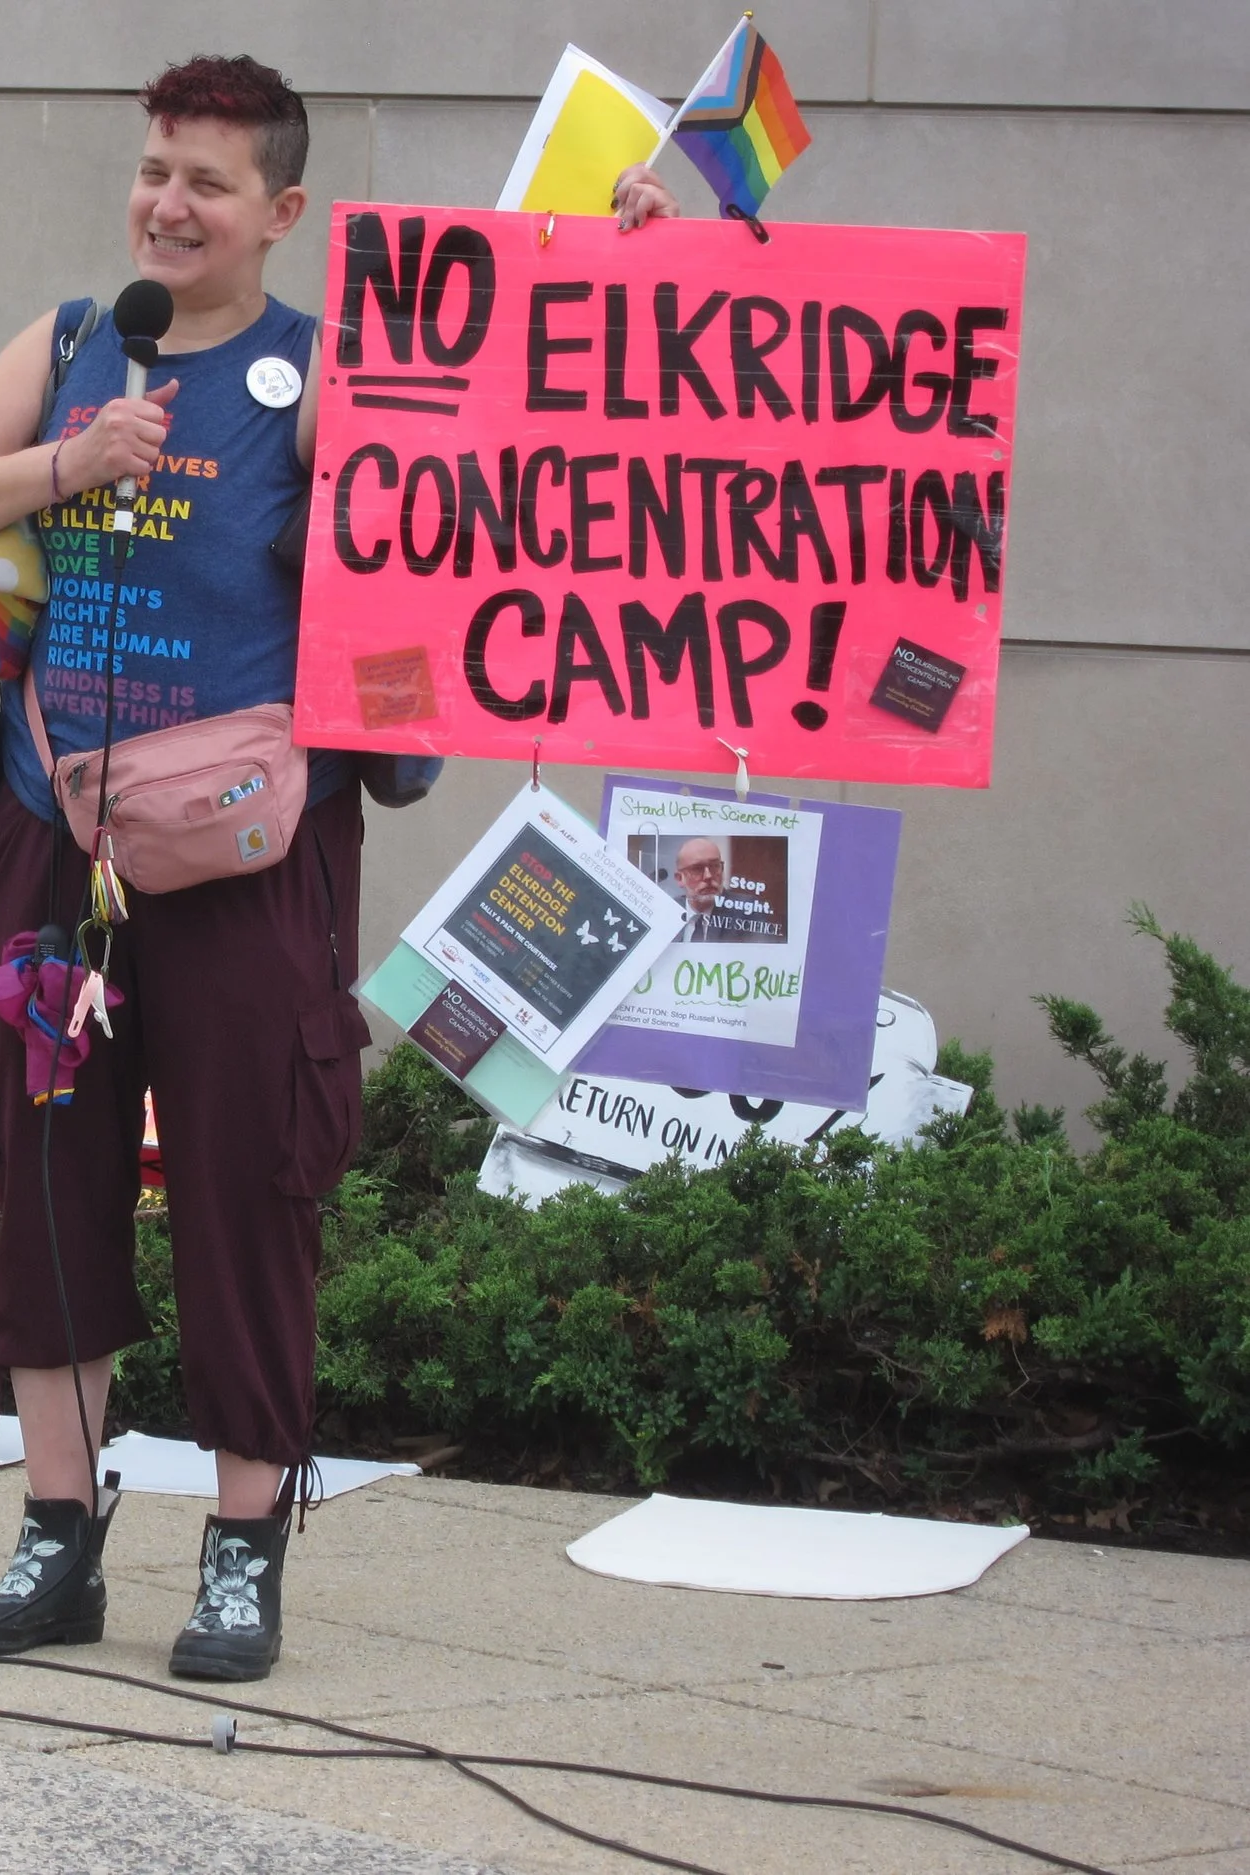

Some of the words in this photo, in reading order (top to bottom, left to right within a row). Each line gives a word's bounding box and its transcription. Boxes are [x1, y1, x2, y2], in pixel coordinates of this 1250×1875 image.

[336, 211, 496, 368] NO
[526, 281, 1010, 438] ELKRIDGE
[149, 454, 219, 479] IVES
[333, 442, 1005, 602] CONCENTRATION
[50, 600, 126, 628] RIGHTS
[48, 645, 124, 674] RIGHTS
[49, 622, 84, 645] ARE
[92, 627, 191, 660] HUMAN
[465, 588, 848, 732] CAMP!
[894, 646, 915, 662] NO
[948, 674, 960, 683] MD
[895, 659, 953, 689] CONCENTRATION
[44, 667, 161, 704] KINDNESS
[170, 685, 195, 707] IS
[620, 795, 666, 817] Stand
[509, 863, 569, 917] ELKRIDGE
[520, 852, 553, 880] STOP
[551, 878, 577, 903] THE
[729, 875, 766, 895] Stop
[489, 888, 536, 932] CENTER
[498, 876, 567, 936] DETENTION
[701, 914, 733, 930] SAVE
[714, 895, 774, 916] Vought.
[479, 901, 497, 919] RALLY
[499, 918, 516, 935] PACK
[513, 930, 527, 944] THE
[523, 940, 559, 972] COURTHOUSE
[674, 959, 751, 1002] OMB
[441, 999, 490, 1042] CONCENTRATION
[442, 987, 463, 1005] NO
[488, 1026, 499, 1038] MD
[642, 1017, 651, 1025] of
[650, 1017, 680, 1028] Science
[670, 1010, 687, 1020] Stop
[688, 1013, 716, 1023] Russell
[716, 1016, 748, 1028] Vought's
[661, 1116, 702, 1153] ON
